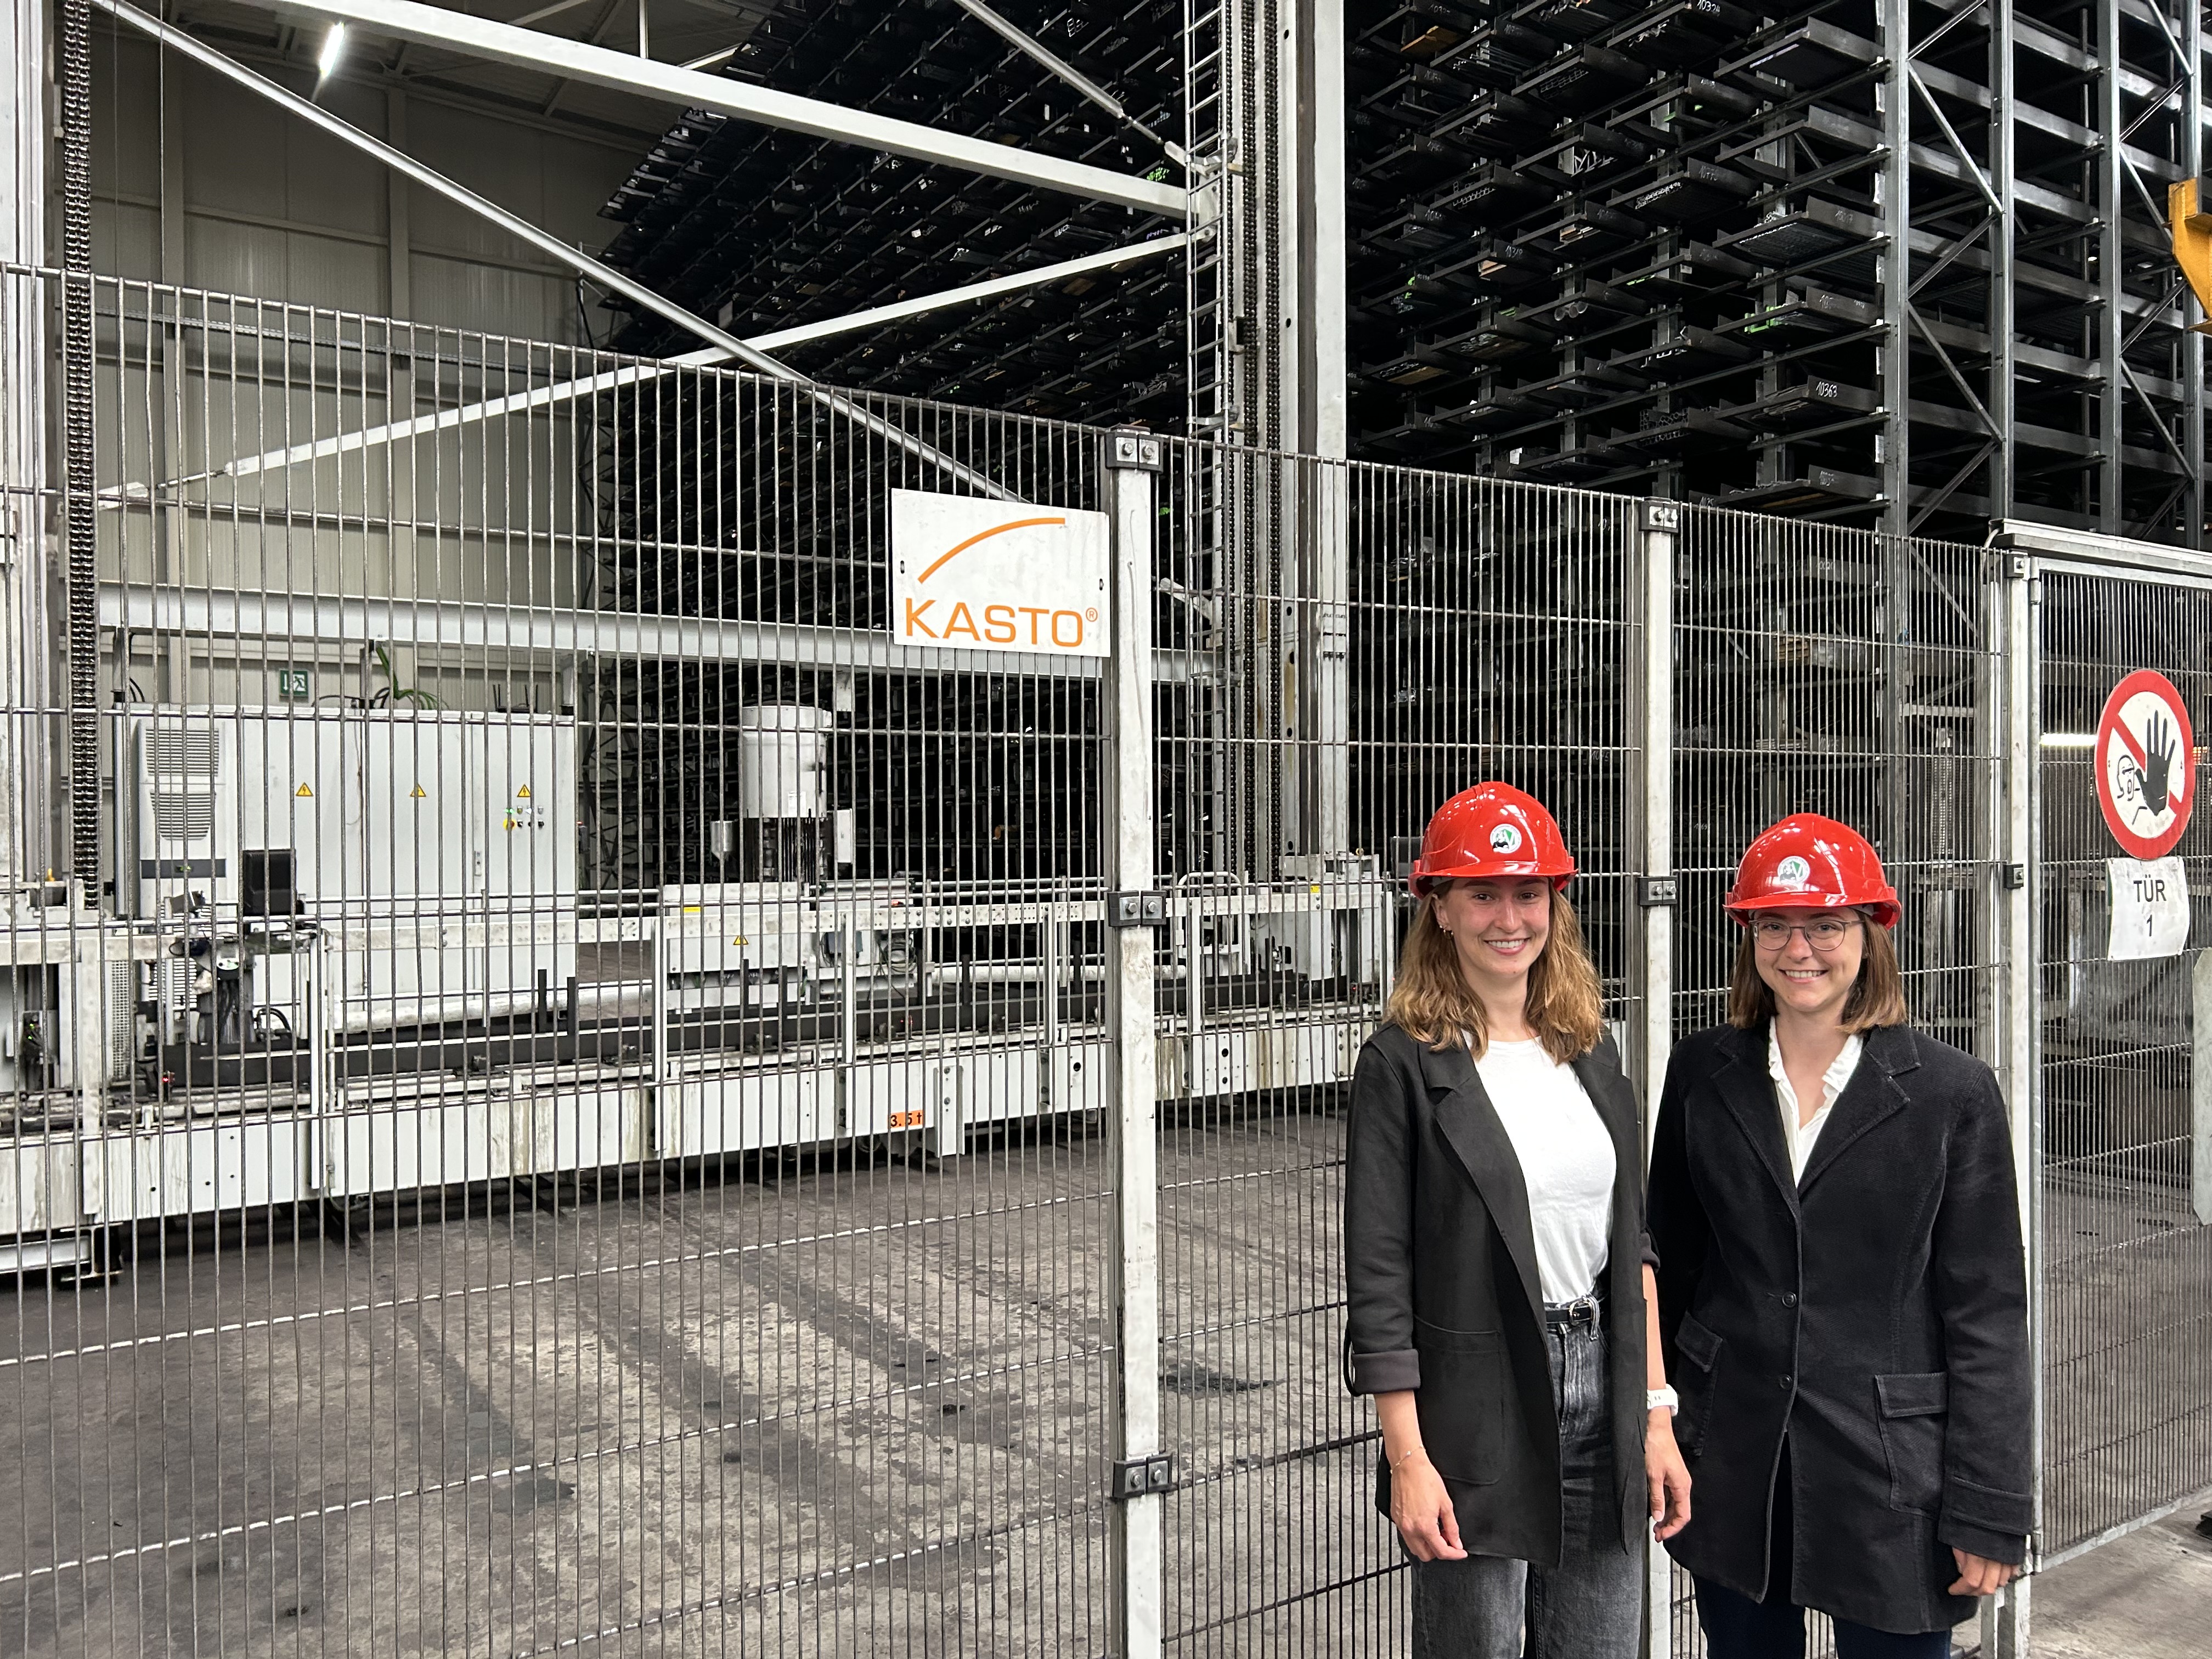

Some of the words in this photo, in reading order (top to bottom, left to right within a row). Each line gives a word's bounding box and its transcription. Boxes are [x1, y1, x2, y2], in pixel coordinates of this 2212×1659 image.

[1815, 381, 1837, 398] 10363
[2133, 874, 2166, 902] TÜR
[2146, 914, 2153, 937] 1
